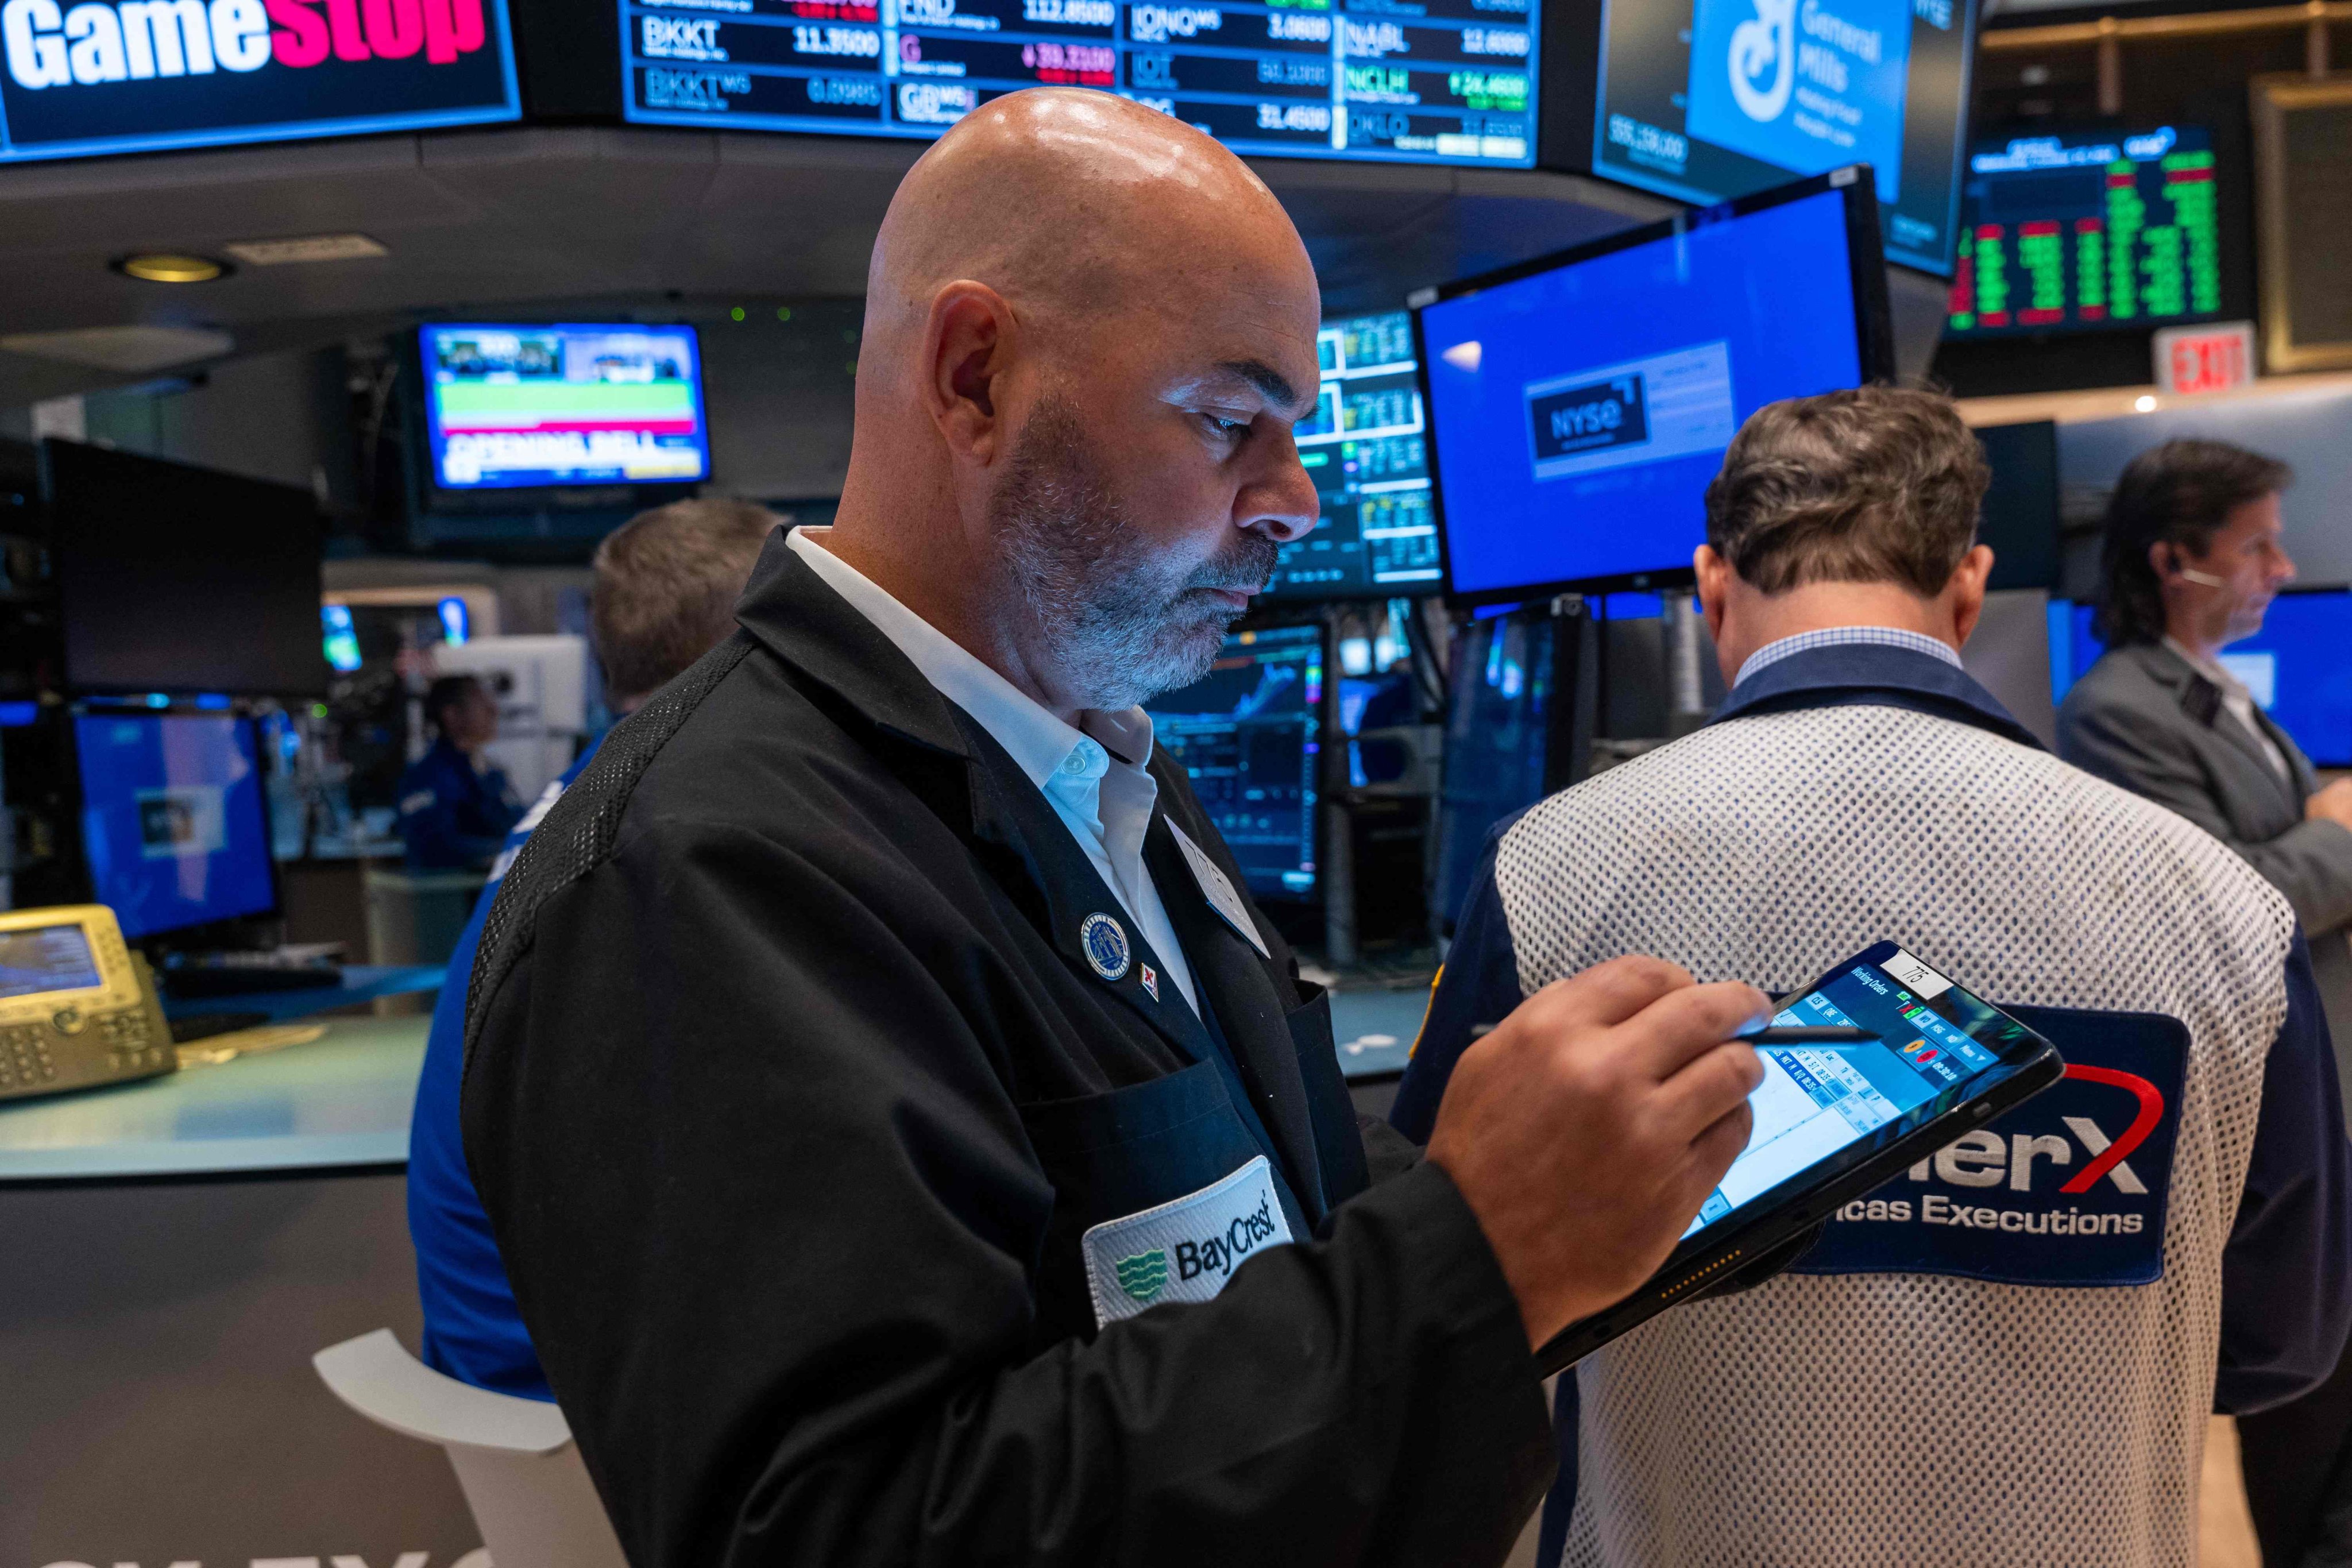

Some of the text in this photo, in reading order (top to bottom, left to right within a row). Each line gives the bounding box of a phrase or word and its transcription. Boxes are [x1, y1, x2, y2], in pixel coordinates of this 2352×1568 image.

[3, 0, 485, 89] GameStop
[642, 16, 720, 48] BKKT
[1801, 0, 1882, 63] General
[899, 34, 921, 62] G
[1797, 43, 1848, 92] Mills
[2172, 334, 2241, 393] EXIT
[1849, 966, 1888, 995] Working Orders
[1902, 965, 1929, 983] 775
[1809, 996, 1824, 1005] CLS
[1929, 1023, 1946, 1034] MSG
[1958, 1044, 1979, 1058] Menu
[1777, 1055, 1794, 1065] MKT
[1824, 1053, 1836, 1061] Loc
[1930, 1061, 1958, 1081] 09:30:10
[1922, 1195, 2144, 1235] Executions
[1175, 1189, 1275, 1281] BayCrest
